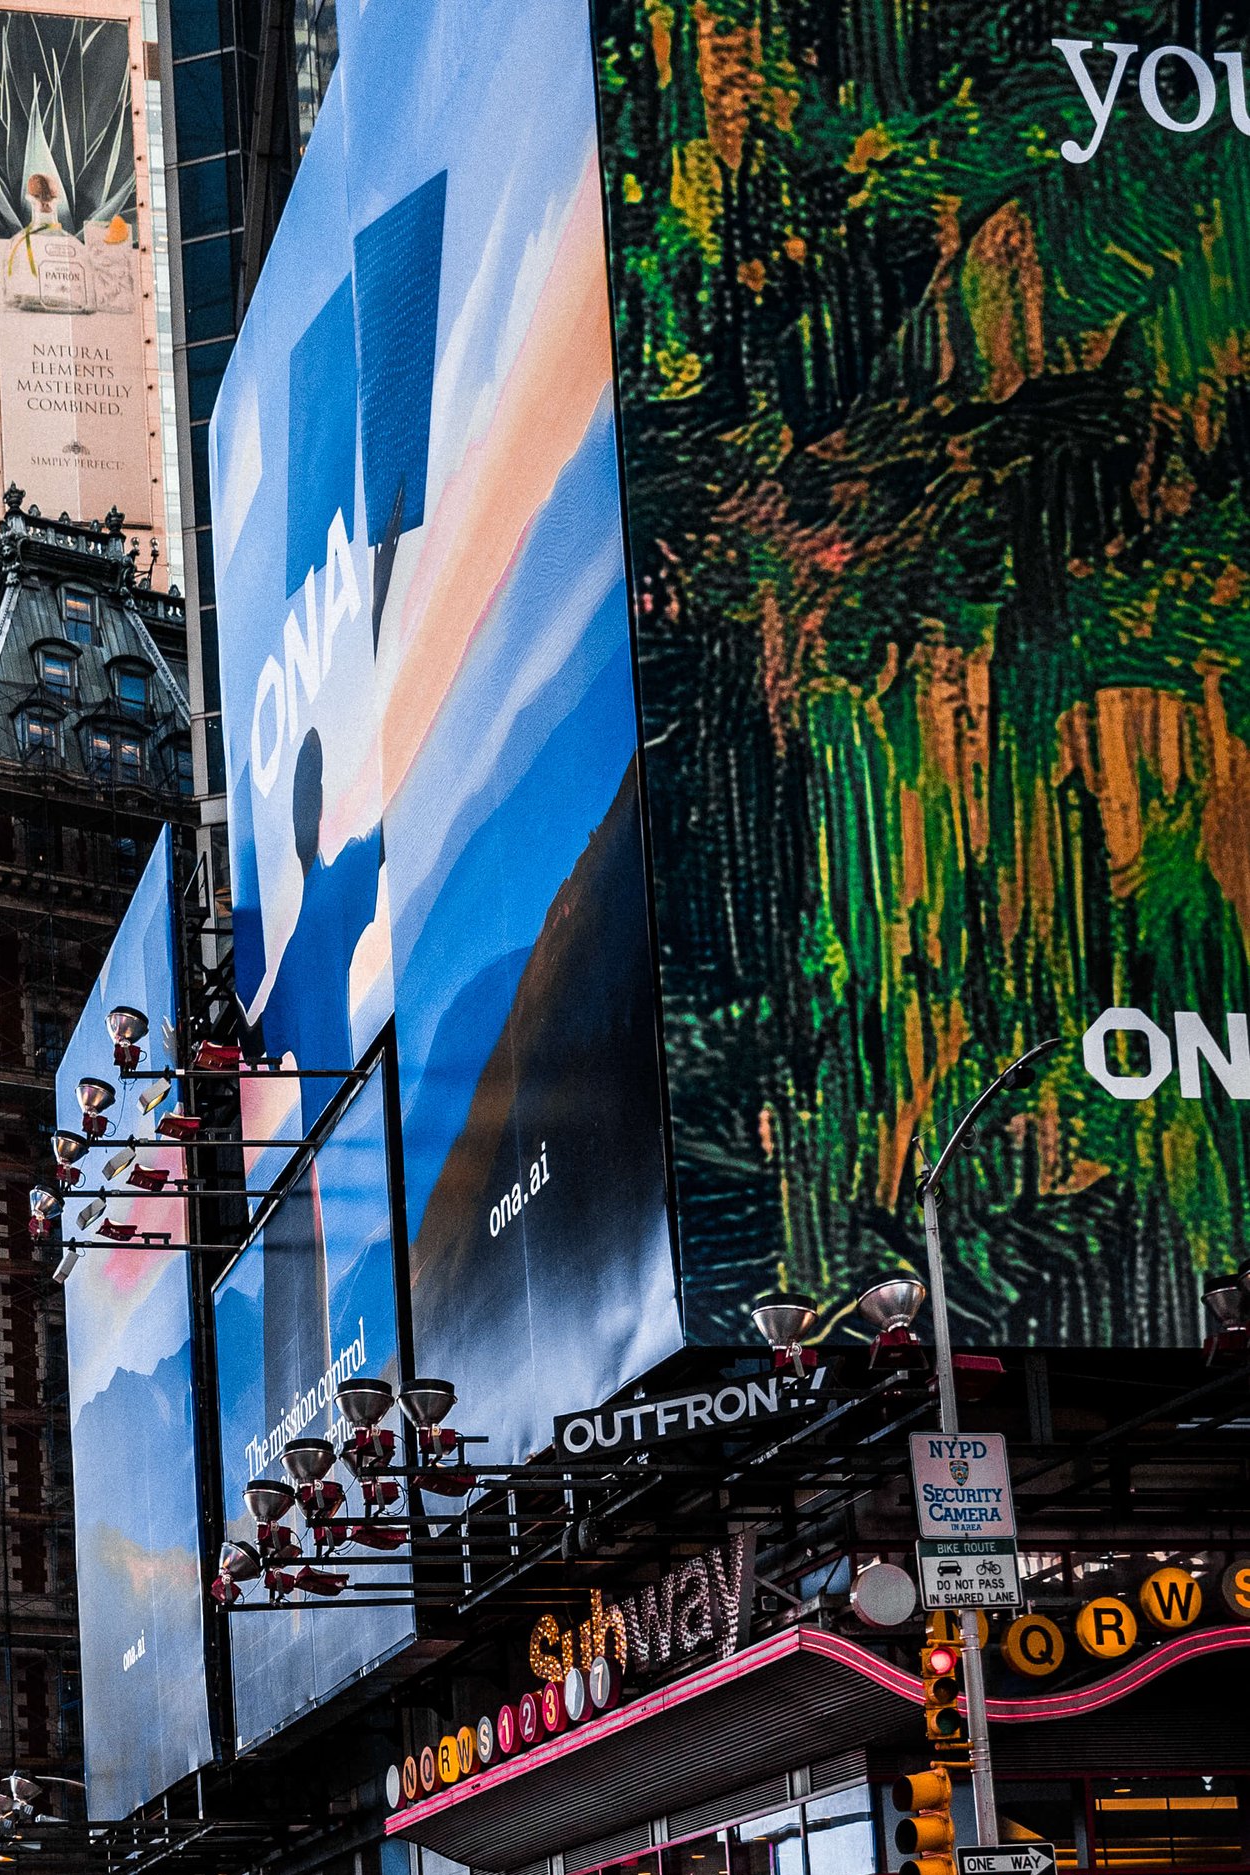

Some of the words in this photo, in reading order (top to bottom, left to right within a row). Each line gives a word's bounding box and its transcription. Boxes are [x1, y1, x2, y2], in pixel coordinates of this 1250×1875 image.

[33, 344, 113, 361] NATURAL
[31, 362, 114, 379] ELEMENTS
[17, 379, 132, 399] MASTERFULLY
[27, 398, 123, 416] COMBINED.
[31, 456, 71, 467] SIMPLY
[251, 506, 362, 799] ONA
[489, 1140, 550, 1238] ona.ai
[245, 1434, 269, 1481] The
[269, 1391, 318, 1463] mission
[318, 1315, 367, 1409] control
[928, 1440, 987, 1459] NYPD
[922, 1484, 1002, 1503] SECURITY
[928, 1503, 1002, 1522] CAMERA
[937, 1543, 960, 1554] BIKE
[964, 1542, 997, 1552] ROUTE
[937, 1580, 950, 1591] DO
[955, 1579, 974, 1590] NOT
[979, 1578, 1005, 1589] PASS
[929, 1594, 940, 1605] IN
[944, 1593, 984, 1604] SHARED
[988, 1592, 1016, 1602] LANE
[1019, 1624, 1054, 1666] Q
[1092, 1607, 1126, 1646] R
[1152, 1582, 1194, 1622] W
[406, 1764, 414, 1793] N
[423, 1756, 434, 1783] Q
[442, 1745, 450, 1775] R
[457, 1738, 471, 1770] W
[480, 1724, 490, 1755] S
[502, 1713, 510, 1744] 1
[522, 1703, 533, 1735] 2
[546, 1689, 557, 1724] 3
[594, 1663, 603, 1700] 7
[967, 1857, 996, 1871] ONE
[1011, 1855, 1042, 1870] WAY
